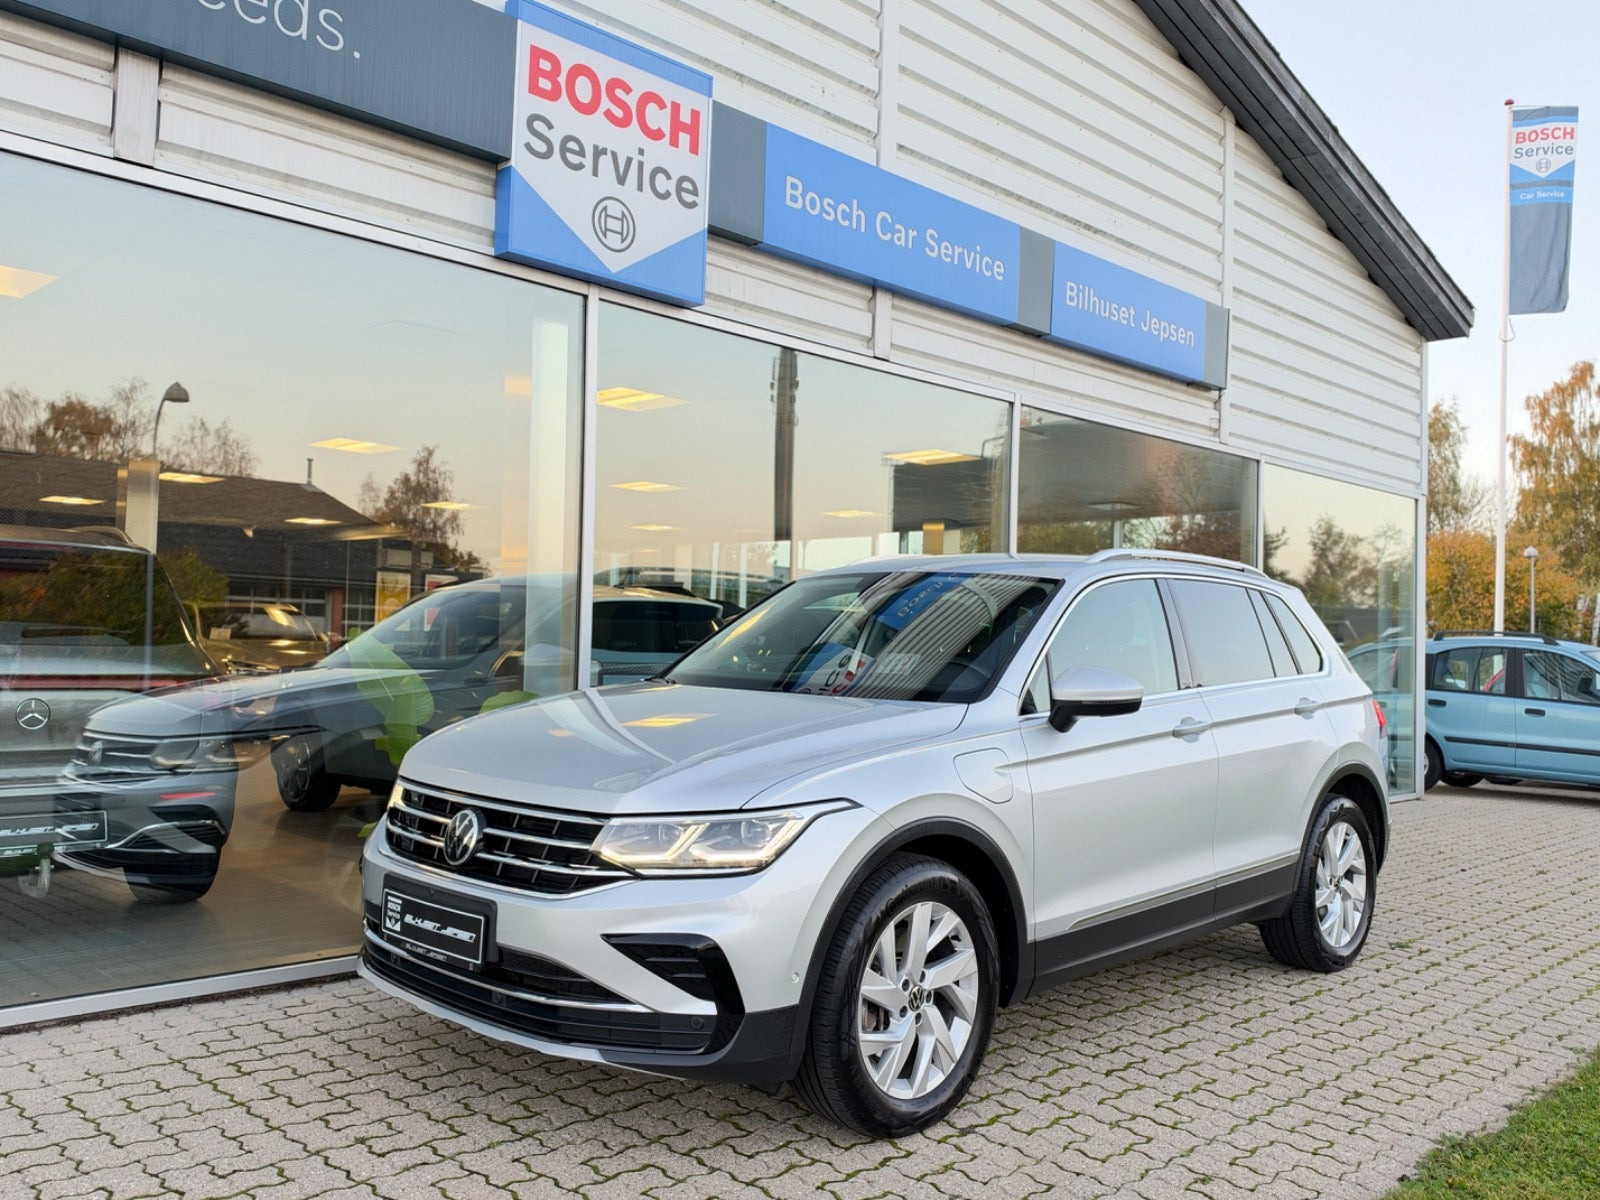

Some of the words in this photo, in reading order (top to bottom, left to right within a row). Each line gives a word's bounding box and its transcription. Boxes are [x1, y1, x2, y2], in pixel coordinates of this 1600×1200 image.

[198, 0, 361, 59] eds.
[528, 44, 701, 156] BOSCH
[523, 112, 700, 210] Service
[1513, 142, 1574, 159] Service
[1515, 127, 1575, 144] BOSCH
[1520, 192, 1535, 200] Car
[1536, 189, 1565, 199] Service
[785, 175, 866, 233] Bosch
[875, 211, 918, 250] Car
[925, 229, 1006, 281] Service
[1066, 280, 1136, 328] Bilhuset
[1141, 310, 1195, 347] Jepsen
